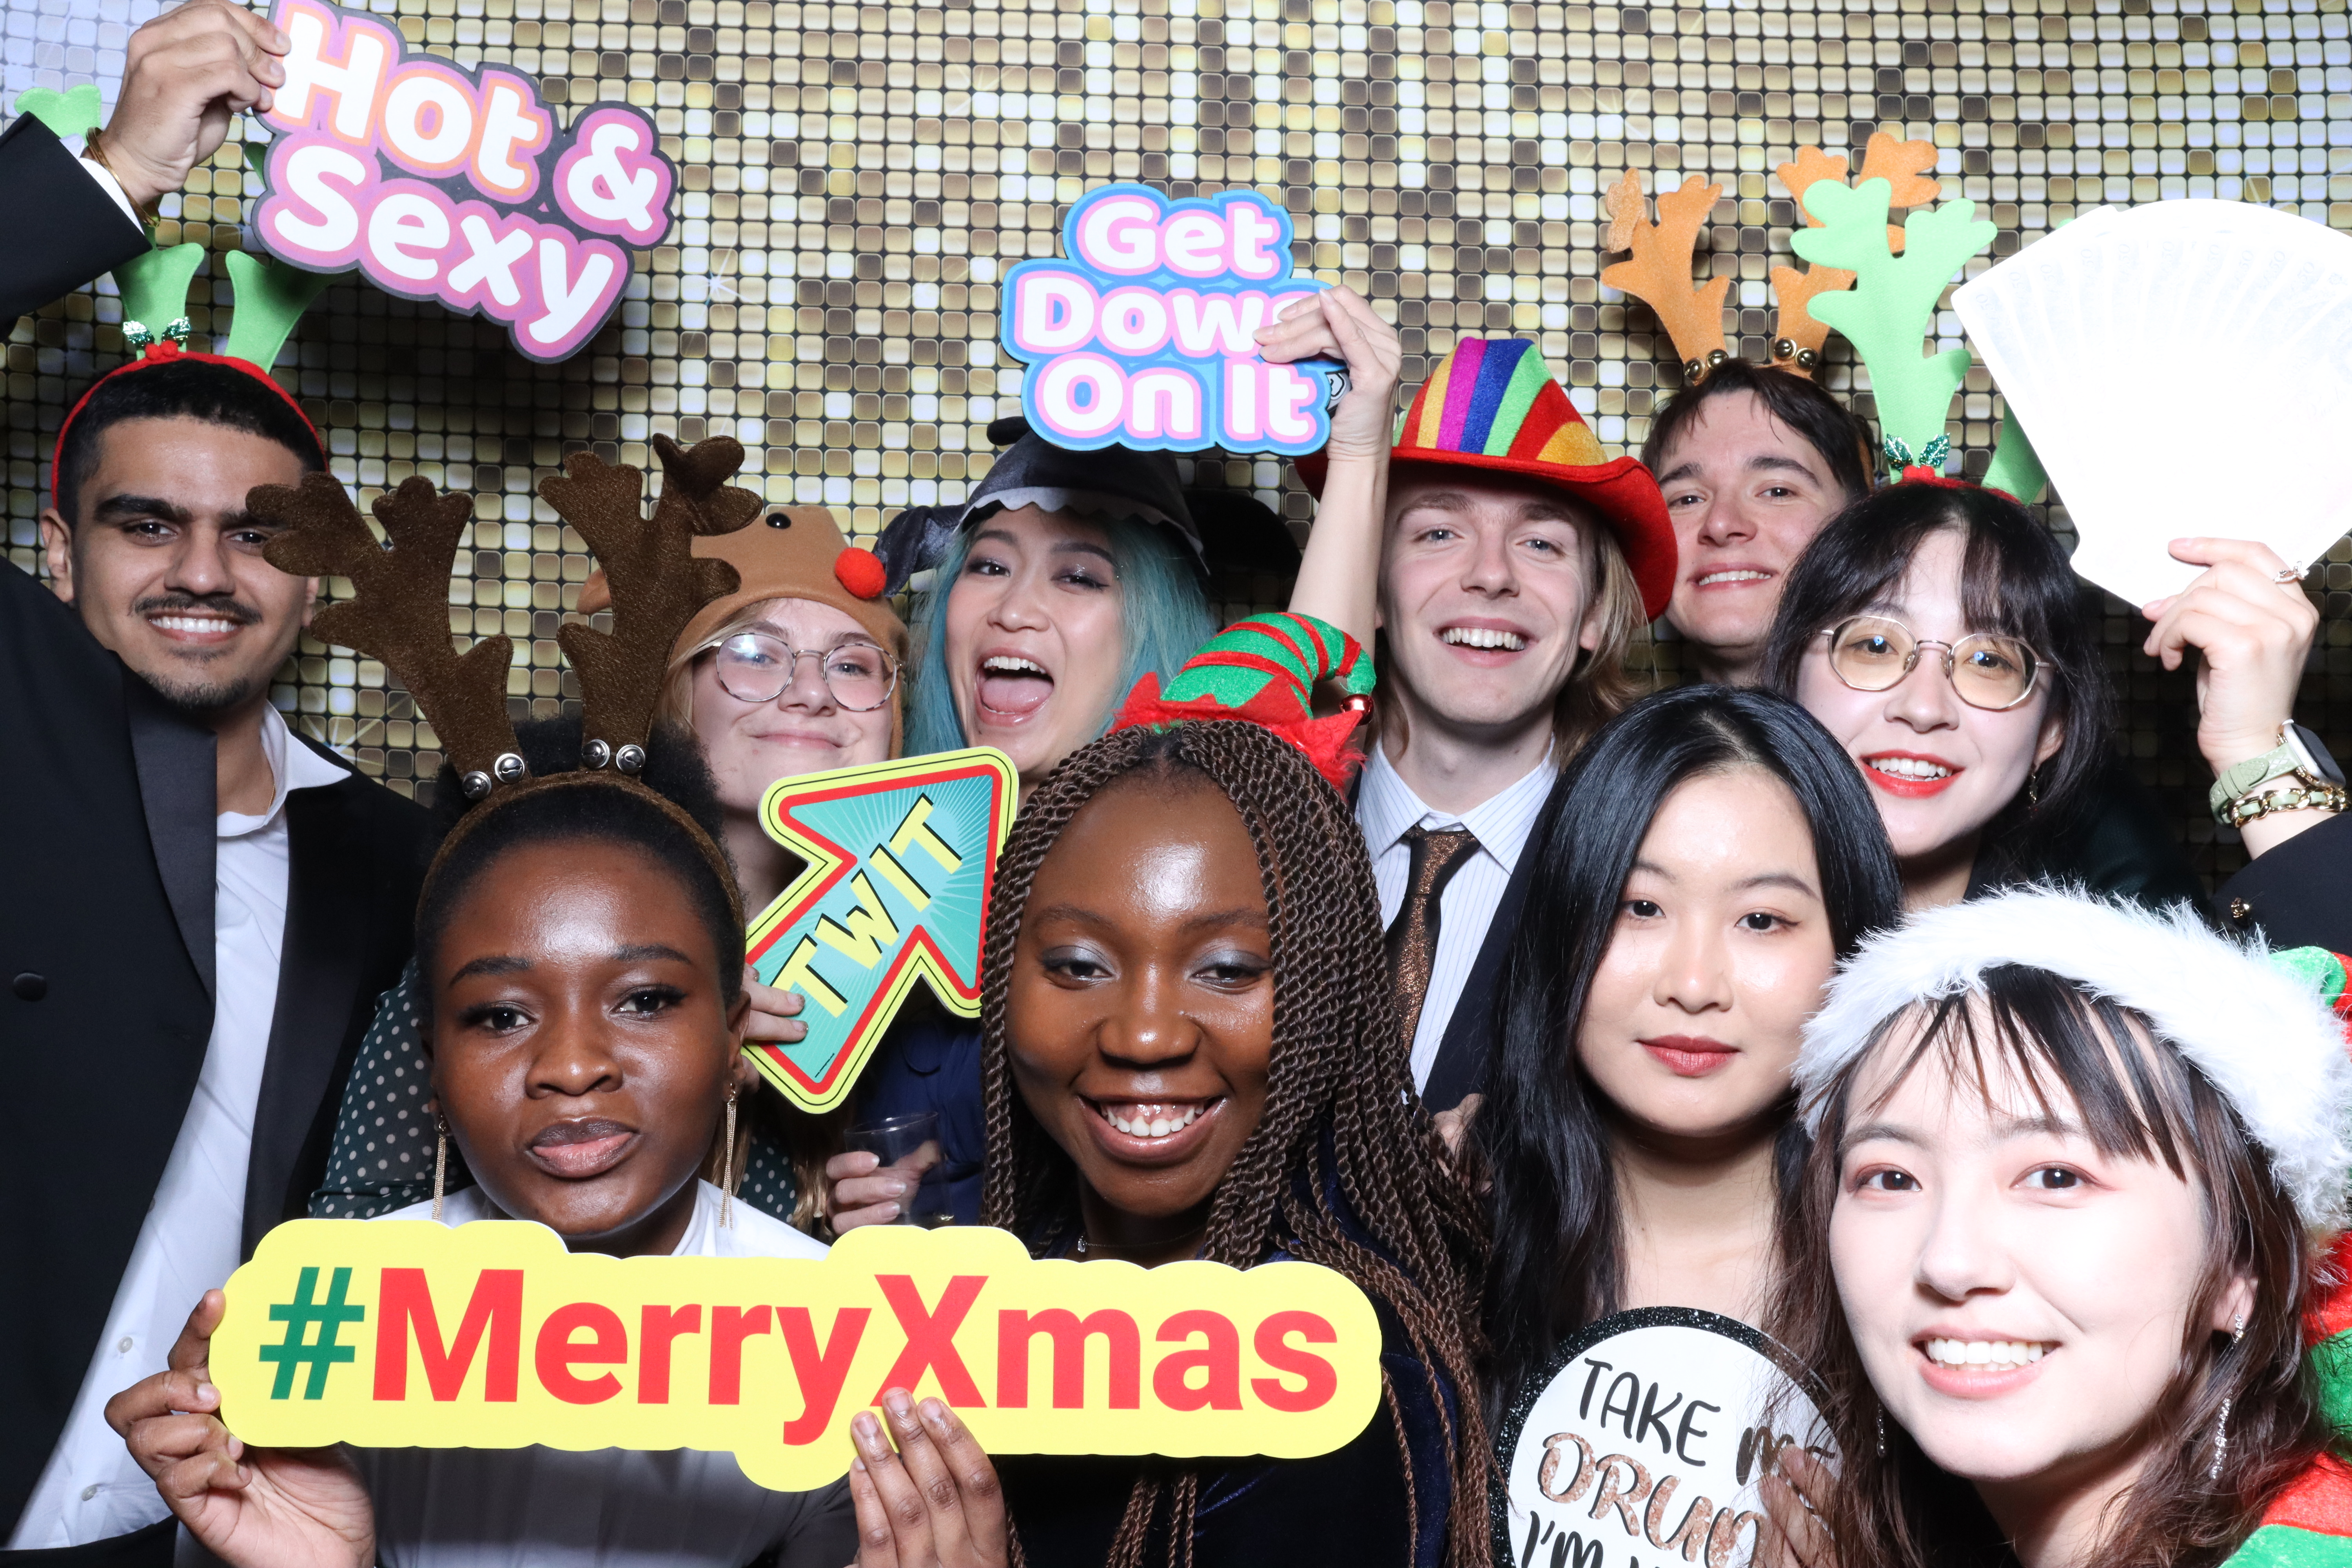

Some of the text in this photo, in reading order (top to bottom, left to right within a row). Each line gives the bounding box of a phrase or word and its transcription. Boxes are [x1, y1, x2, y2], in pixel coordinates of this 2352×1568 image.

[273, 11, 658, 232] Hot &
[274, 145, 614, 343] Sexy
[1085, 201, 1274, 273] Get
[1022, 277, 1308, 353] Dow
[1043, 359, 1308, 437] On It
[770, 792, 962, 1018] TWIT
[259, 1267, 1338, 1445] #MerryXmas
[1579, 1357, 1720, 1466] TAKE
